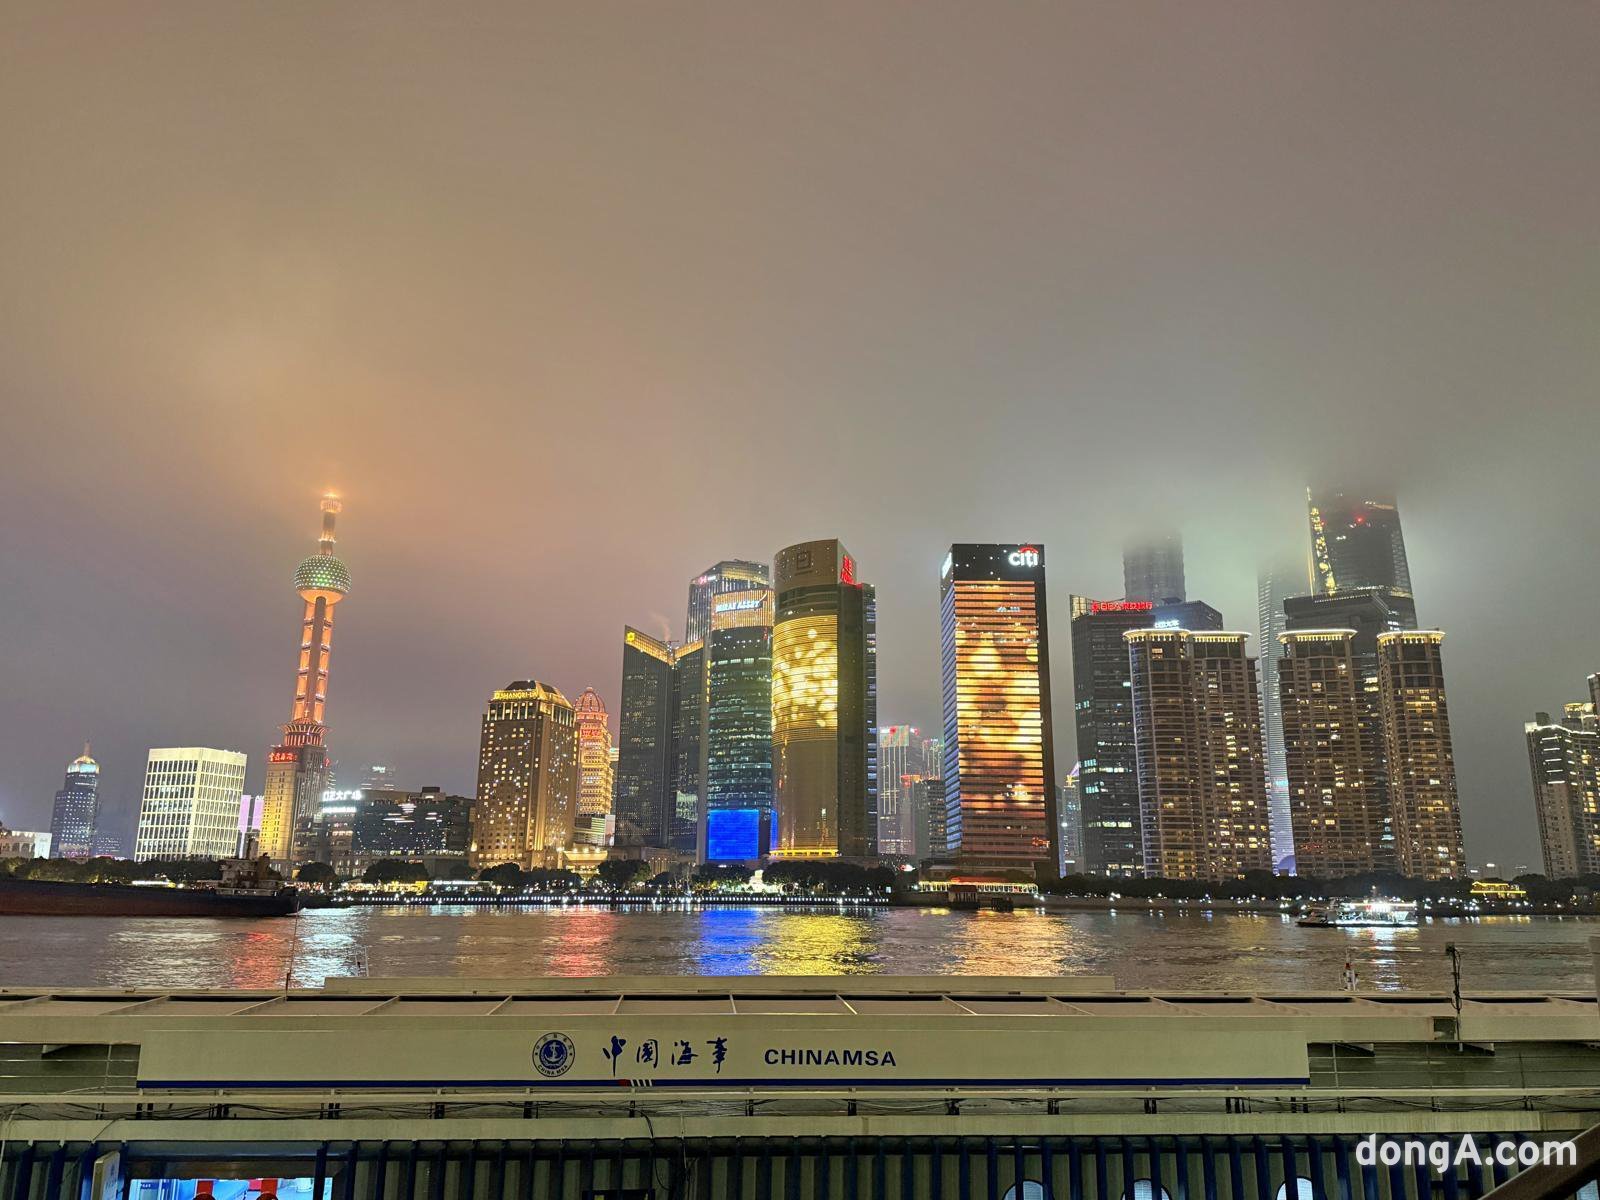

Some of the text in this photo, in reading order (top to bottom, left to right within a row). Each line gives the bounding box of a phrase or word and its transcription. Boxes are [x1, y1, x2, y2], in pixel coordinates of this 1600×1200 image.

[1008, 549, 1040, 568] citi
[763, 1048, 897, 1067] CHINAMSA
[537, 1064, 555, 1076] CHINA
